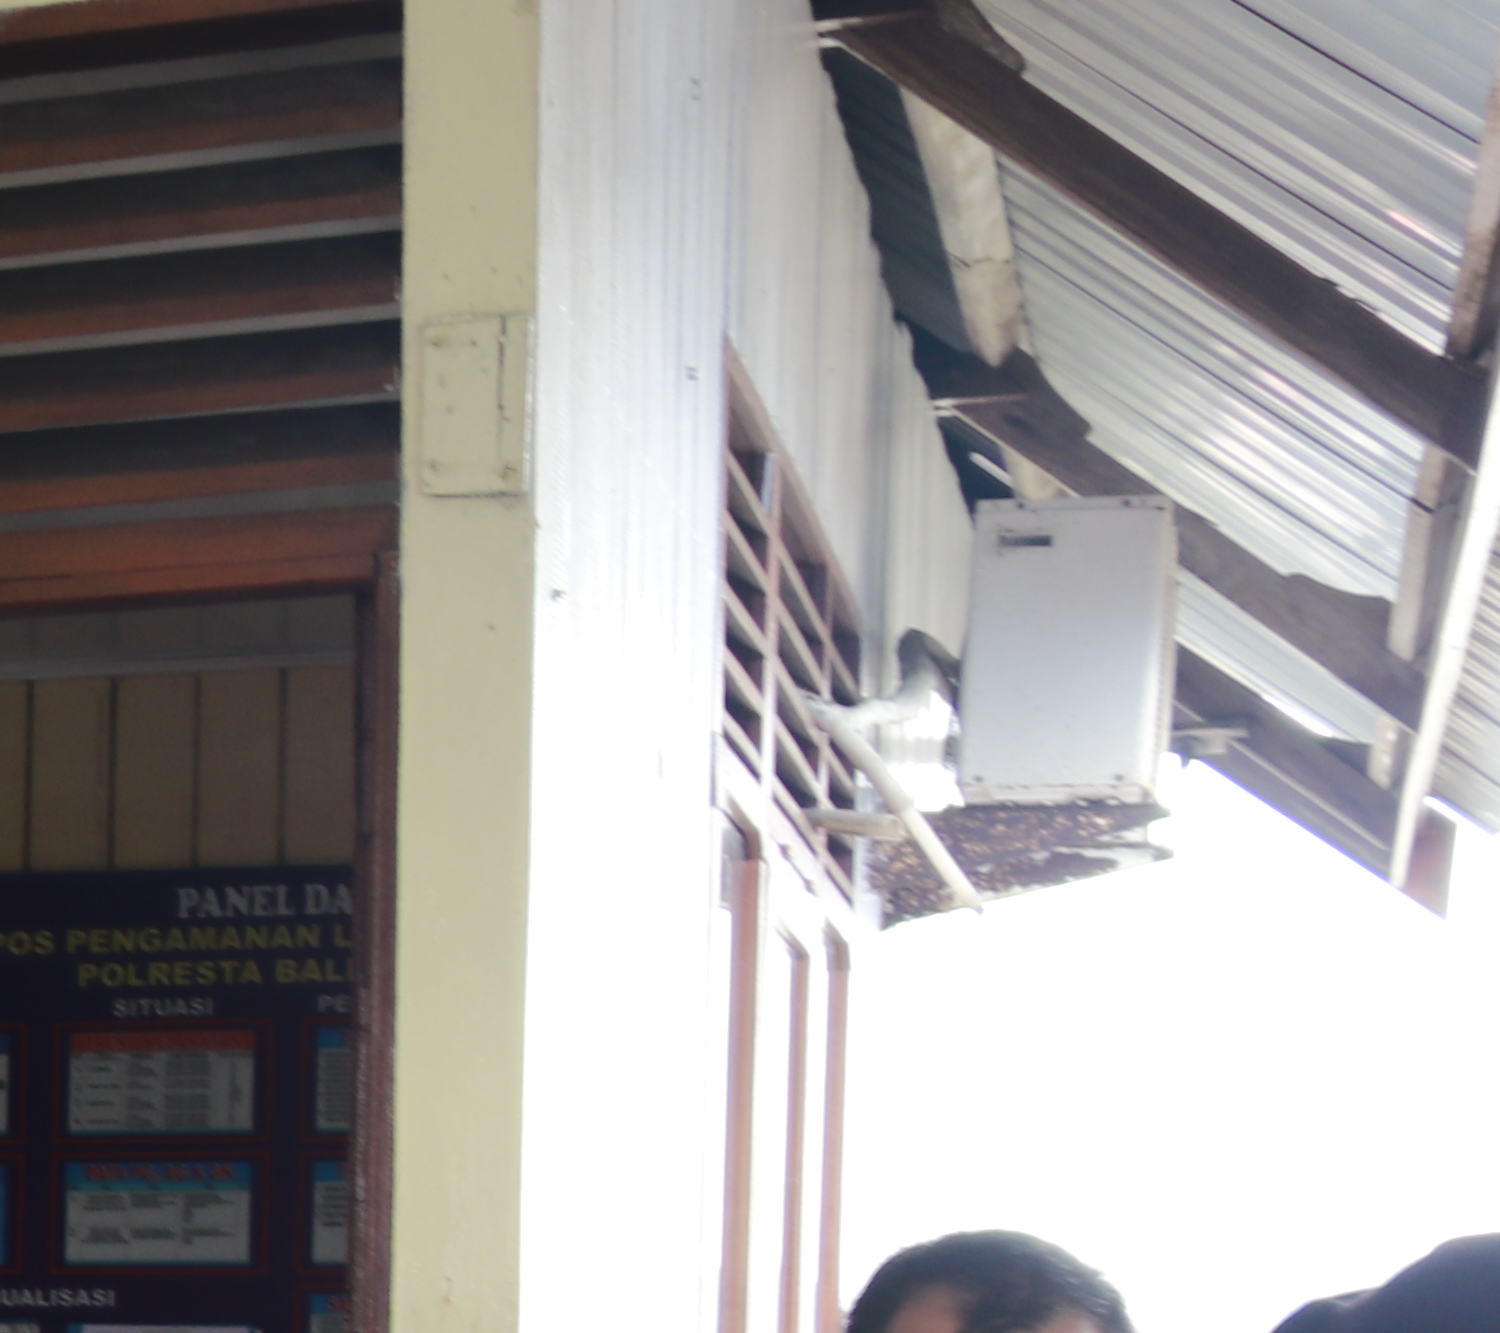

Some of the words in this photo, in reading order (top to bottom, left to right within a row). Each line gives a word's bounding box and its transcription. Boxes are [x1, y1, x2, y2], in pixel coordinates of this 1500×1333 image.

[177, 885, 296, 918] PANEL
[65, 924, 322, 954] PENGAMANAN
[77, 960, 264, 988] POLRESTA
[111, 997, 215, 1018] SITUASI
